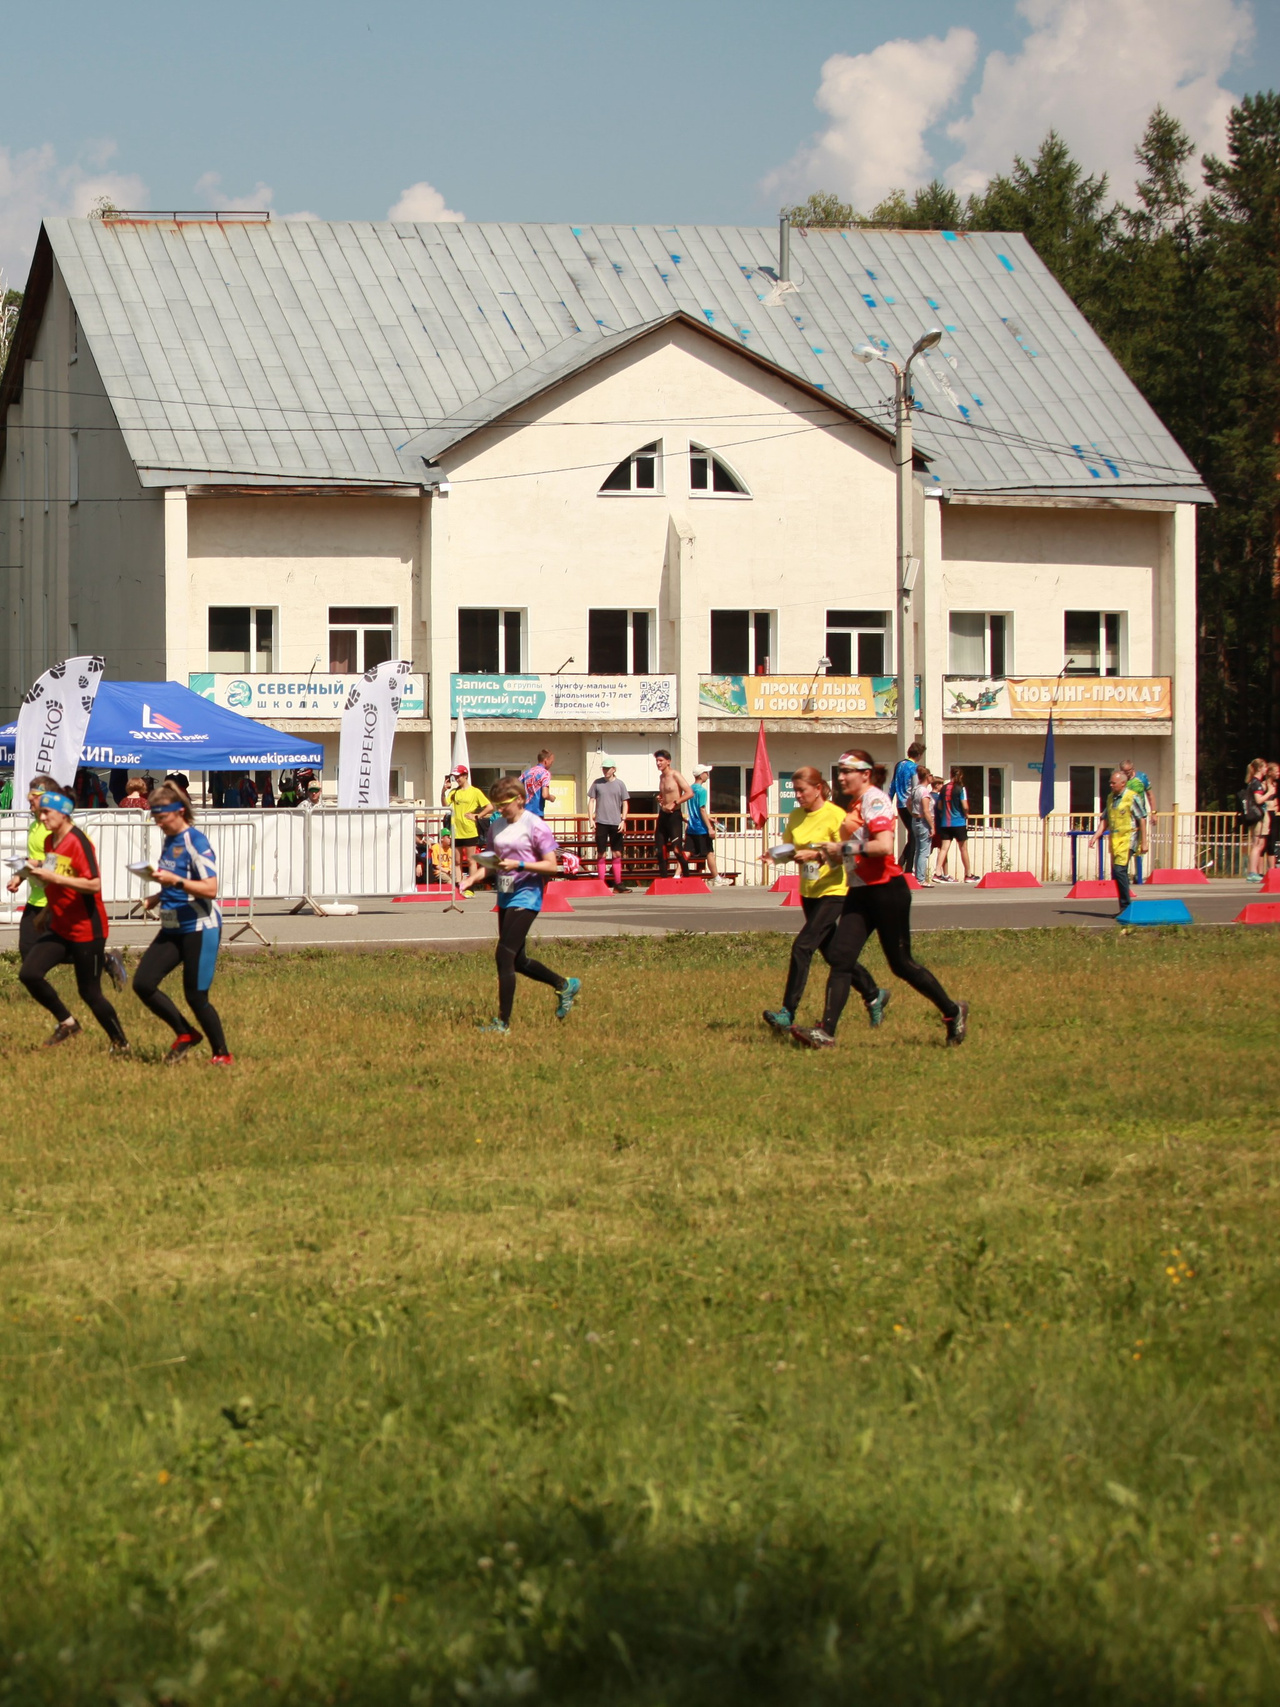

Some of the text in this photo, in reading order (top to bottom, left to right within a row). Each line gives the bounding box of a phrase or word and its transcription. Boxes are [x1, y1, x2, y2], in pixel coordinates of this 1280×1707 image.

[257, 680, 344, 695] СЕВЕРНЫЙ
[455, 679, 500, 690] Запись
[760, 682, 861, 696] ПРОКАТ ЛЫЖ
[455, 693, 537, 706] круглый год!
[1014, 685, 1163, 702] ТЮБИНГ-ПРОКАТ
[257, 701, 319, 709] ШКОЛА
[754, 698, 867, 712] И СНОУБОРДОВ
[35, 707, 63, 775] ЕРЕКО
[229, 752, 321, 765] www.ekiprace.ru
[358, 711, 377, 808] ИБЕРЕКО
